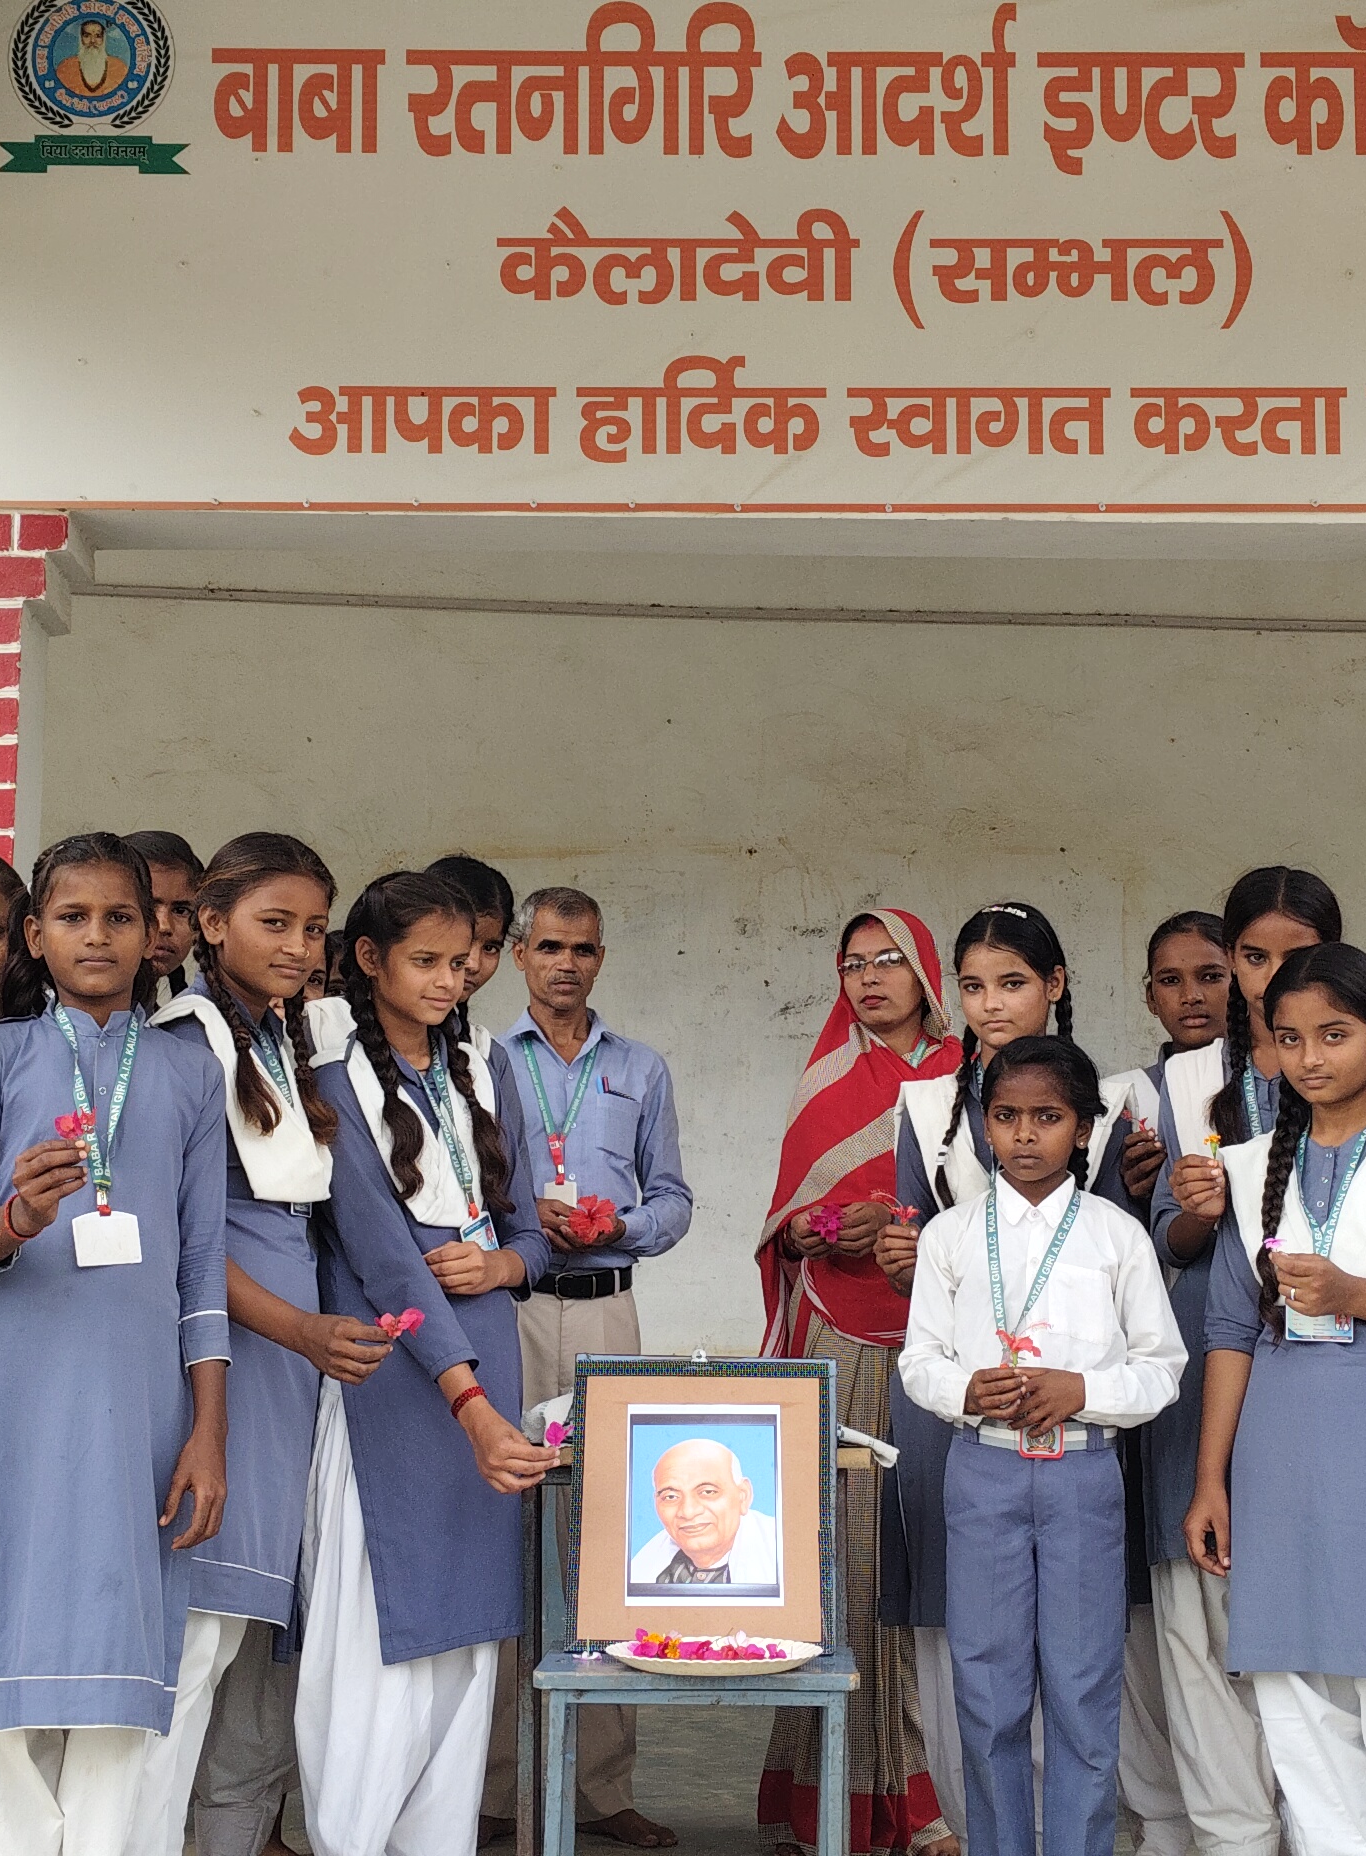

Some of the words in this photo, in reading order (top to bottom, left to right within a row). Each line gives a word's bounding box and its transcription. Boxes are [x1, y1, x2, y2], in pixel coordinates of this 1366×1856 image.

[212, 48, 386, 155] बाबा
[406, 1, 762, 158] रतनगिरि
[776, 3, 1017, 159] आदर्श
[1037, 51, 1246, 176] इण्टर
[496, 207, 861, 306] कैलादेवी
[892, 209, 1253, 329] (सम्भल)
[289, 386, 557, 456] आपका
[576, 356, 828, 463] हार्दिक
[847, 387, 1111, 458] स्वागत
[1130, 387, 1347, 456] करता
[258, 1030, 273, 1055] KAIL
[114, 1081, 127, 1102] GIRI
[125, 1031, 137, 1056] KAILA
[1246, 1093, 1256, 1112] GIRI
[90, 1143, 103, 1176] BABA
[988, 1206, 996, 1233] KAILA
[1329, 1193, 1346, 1225] RATAN
[991, 1260, 1001, 1281] GIRI
[1027, 1275, 1046, 1308] RATAN
[1042, 1254, 1056, 1275] GIRI
[1062, 1205, 1079, 1231] KAILA
[993, 1283, 1004, 1318] RATAN
